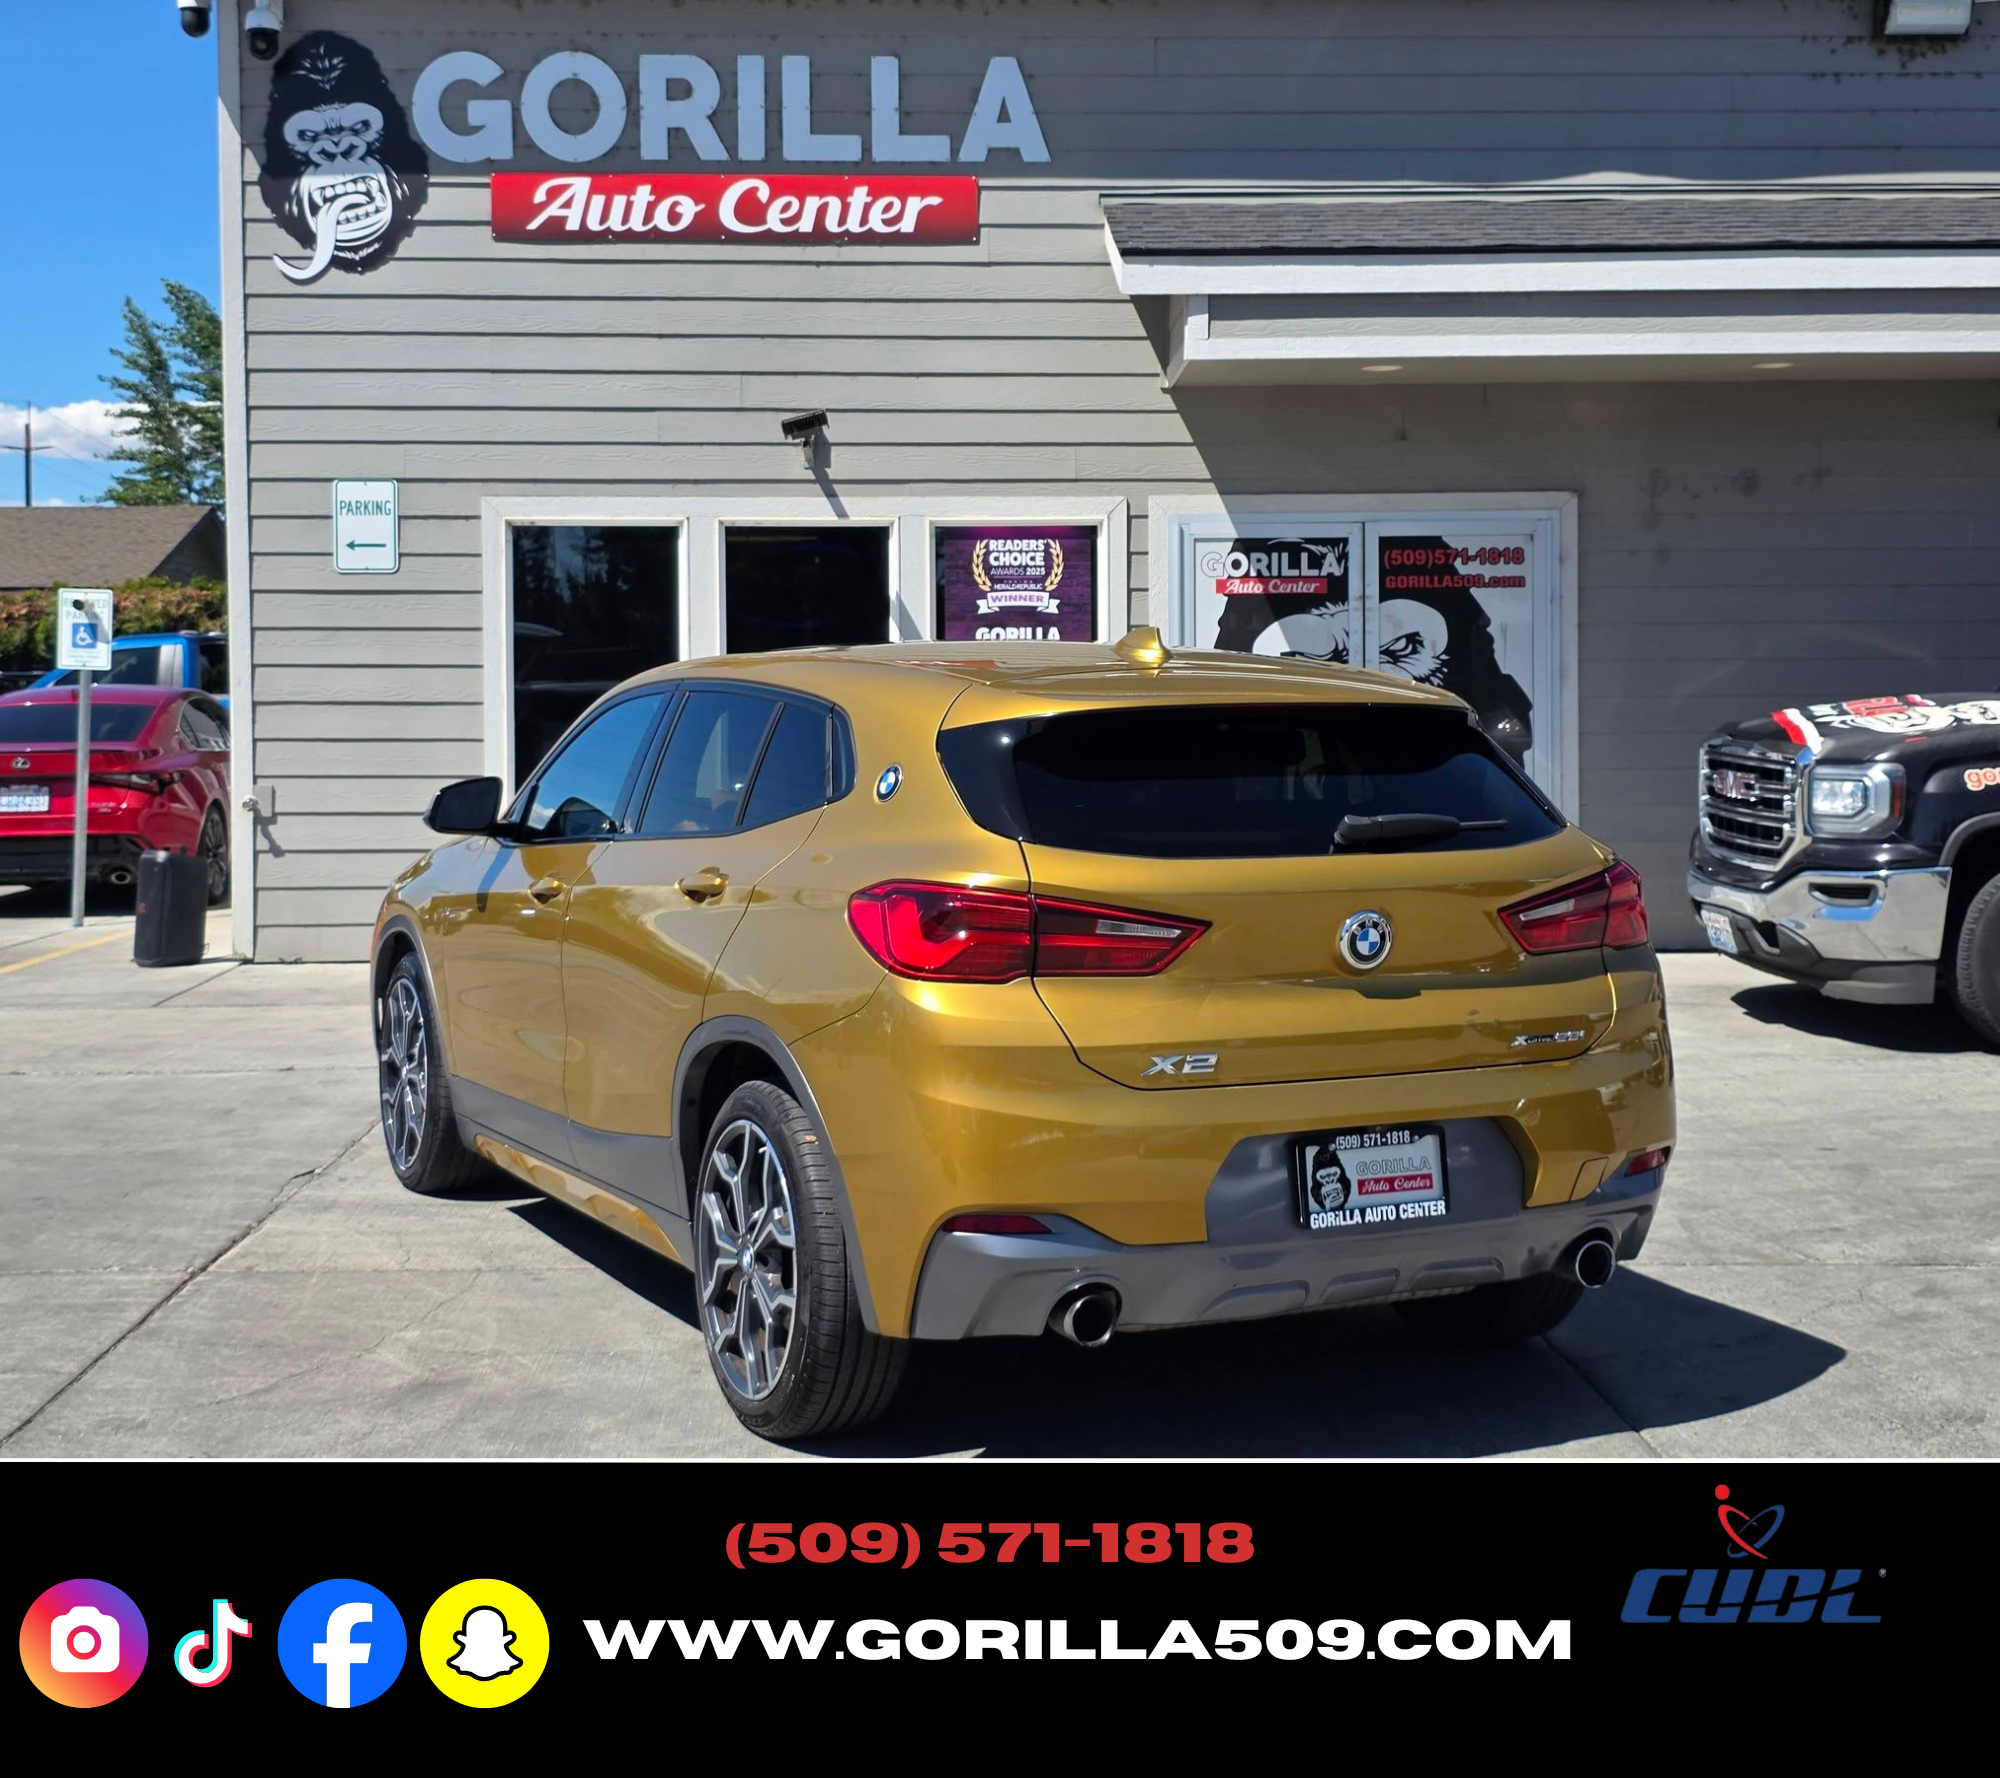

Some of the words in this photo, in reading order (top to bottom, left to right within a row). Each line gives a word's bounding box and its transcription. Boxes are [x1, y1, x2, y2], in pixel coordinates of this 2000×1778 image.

[412, 51, 1051, 163] GORILLA
[525, 176, 706, 234] Auto
[717, 178, 944, 234] Center
[338, 499, 392, 517] PARKING
[989, 539, 1048, 552] READERS'
[989, 552, 1046, 567] CHOICE
[1200, 551, 1343, 578] GORILLA
[1384, 547, 1525, 569] (509)571-1818
[990, 567, 1025, 576] AWARDS
[1025, 567, 1046, 576] 2025
[1385, 574, 1526, 589] GORILLA509.com
[1225, 579, 1264, 594] Auto
[1268, 579, 1320, 594] Center
[990, 594, 1044, 603] WINNER
[1964, 767, 2000, 791] go
[1140, 1053, 1219, 1077] X2
[1335, 1135, 1361, 1150] (509)
[1363, 1130, 1411, 1147] 571-1818
[1355, 1156, 1432, 1176] GORILLA
[1361, 1178, 1391, 1194] Auto
[1393, 1175, 1432, 1191] Center
[1364, 1204, 1397, 1223] AUTO
[1399, 1200, 1446, 1219] CENTER
